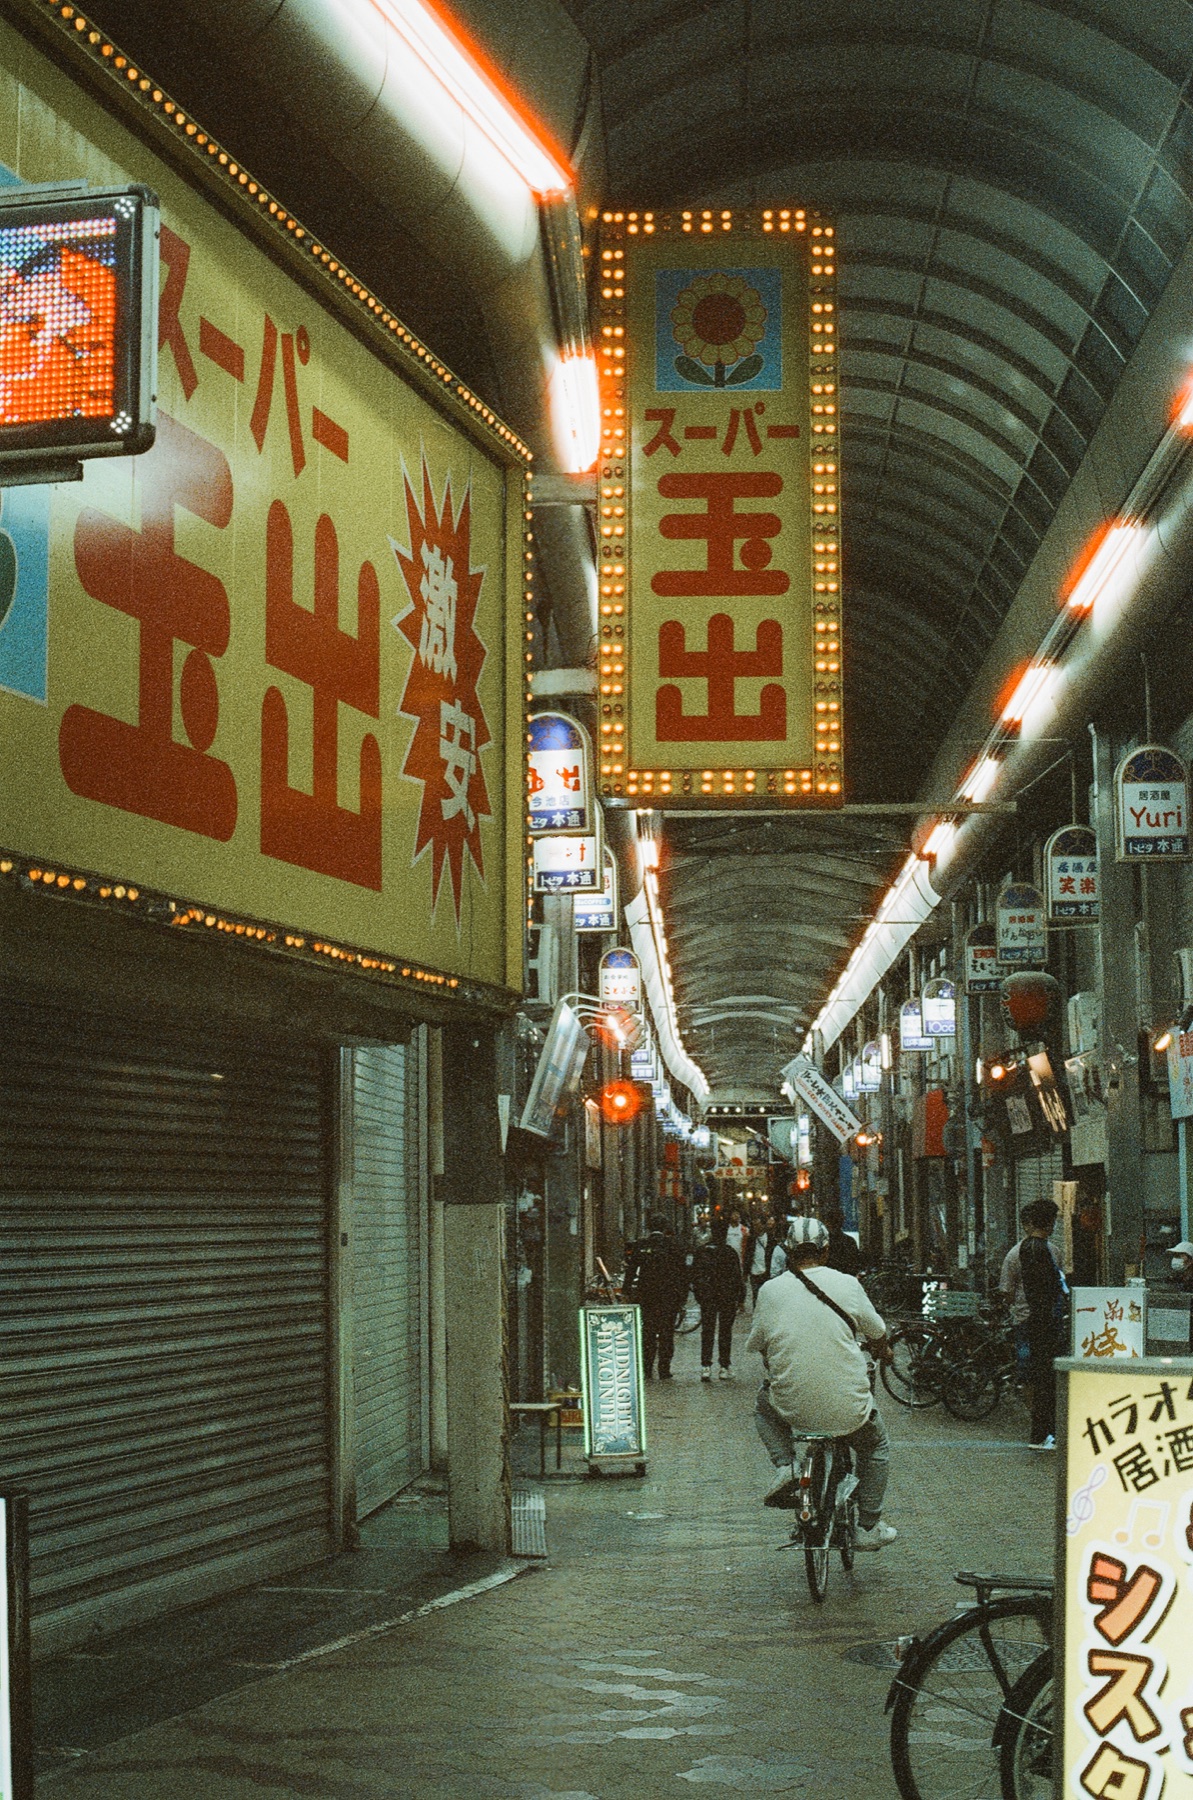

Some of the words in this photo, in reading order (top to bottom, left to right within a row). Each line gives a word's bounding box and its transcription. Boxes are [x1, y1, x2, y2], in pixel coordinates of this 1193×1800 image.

[158, 221, 349, 480] スーパー
[642, 402, 800, 458] スーパー
[651, 472, 790, 742] 玉出
[58, 408, 383, 893] 玉出
[419, 539, 477, 834] 激安
[1129, 805, 1182, 828] Yuri
[1139, 790, 1171, 801] 居酒屋
[1057, 861, 1098, 873] 居酒屋
[1128, 838, 1184, 854] トビタ本通
[540, 870, 593, 887] トビタ本通
[1059, 876, 1097, 895] 笑楽
[596, 1331, 616, 1427] HYACINTH
[614, 1330, 632, 1427] MIDNIGHT
[1112, 1424, 1193, 1493] 居酒
